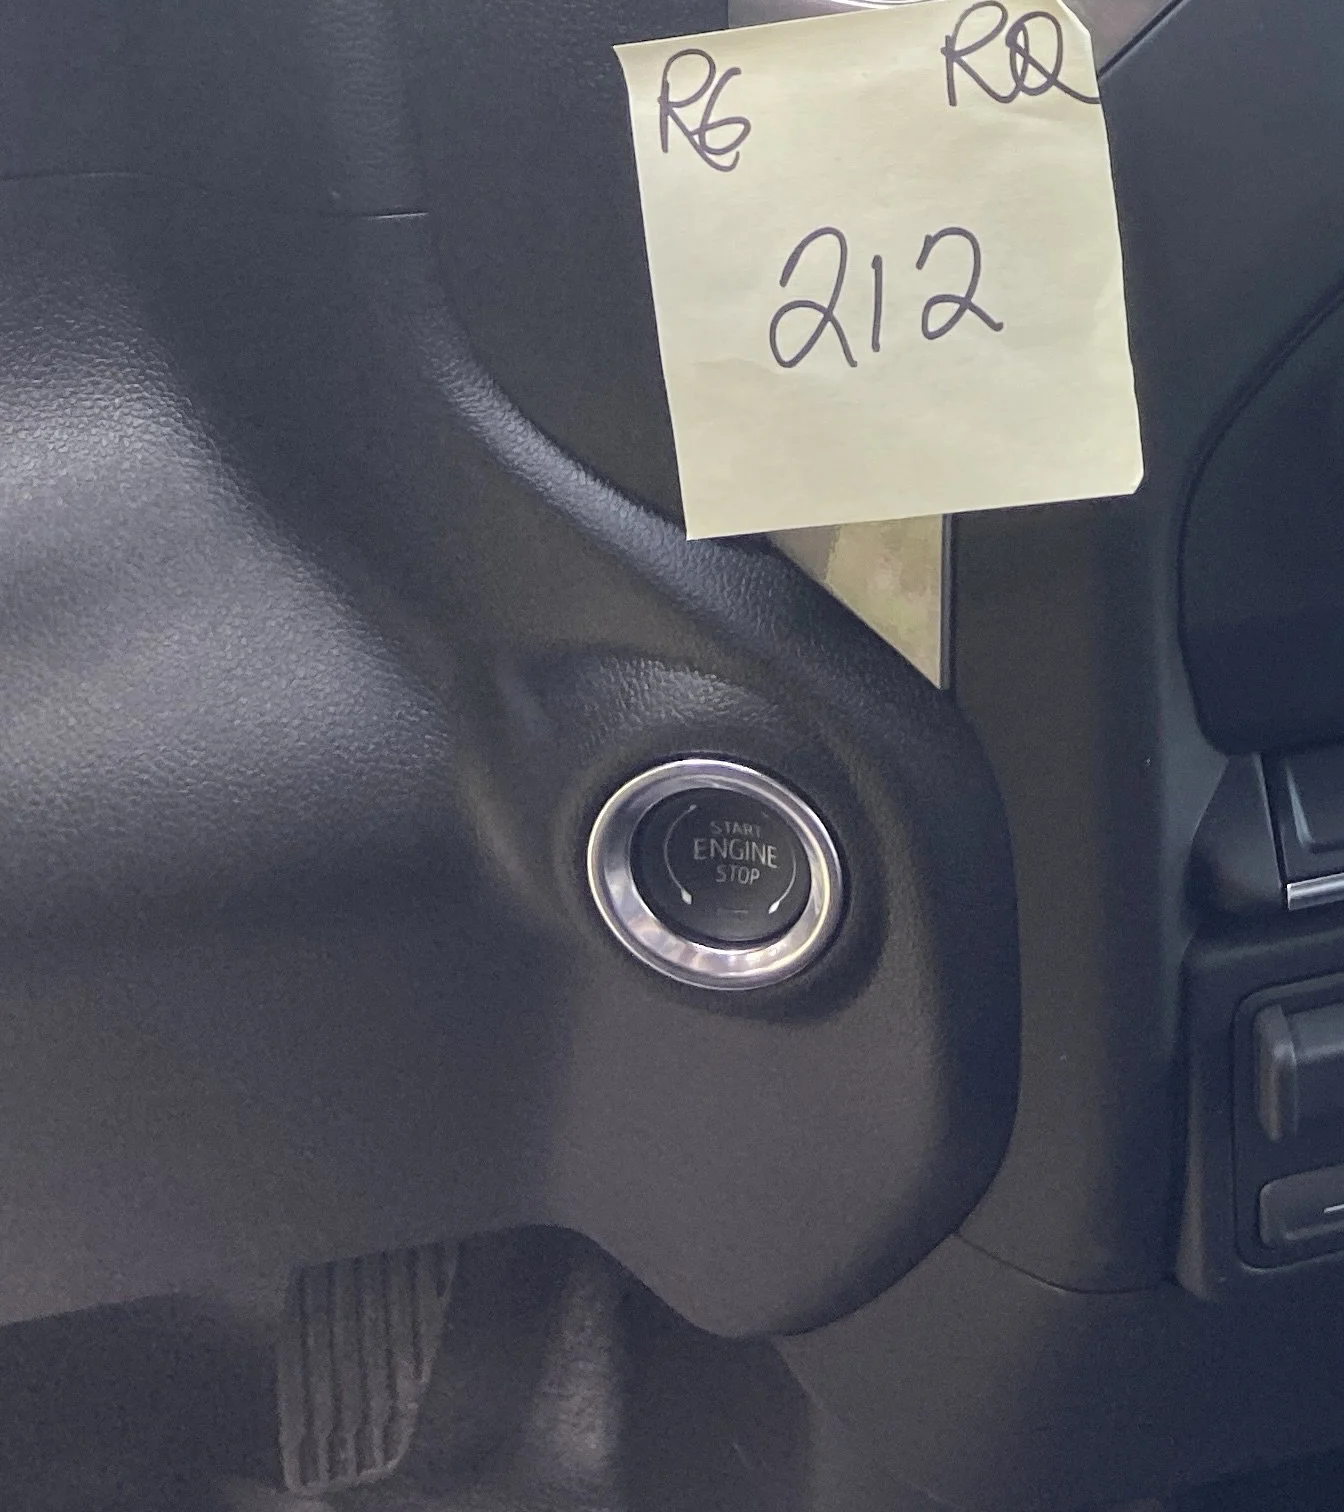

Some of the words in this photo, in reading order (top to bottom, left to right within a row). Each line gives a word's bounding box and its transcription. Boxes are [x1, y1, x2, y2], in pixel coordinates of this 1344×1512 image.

[769, 226, 1004, 369] 212
[710, 821, 762, 837] START
[693, 839, 778, 869] ENGINE
[716, 865, 760, 885] STOP
